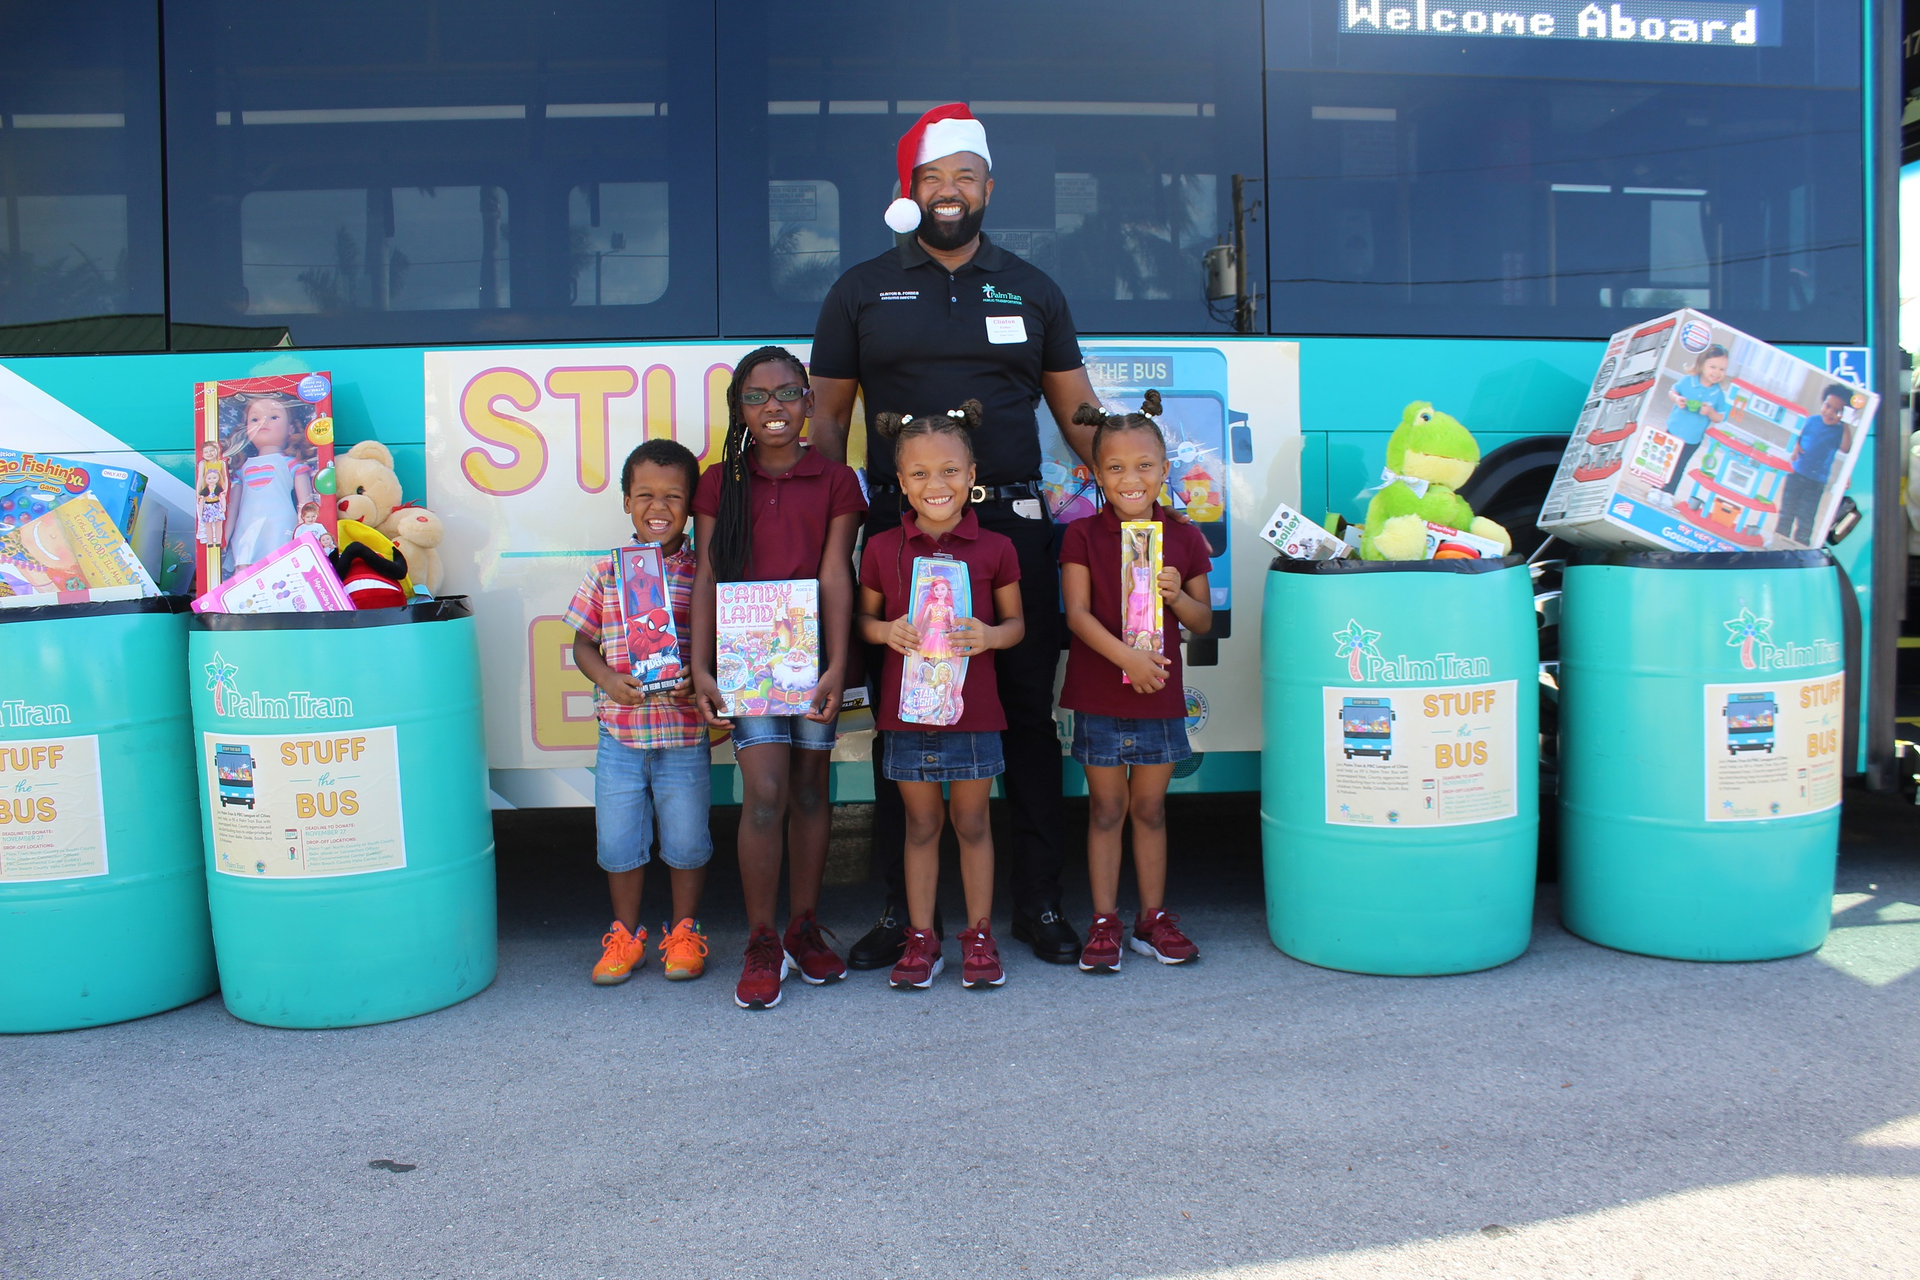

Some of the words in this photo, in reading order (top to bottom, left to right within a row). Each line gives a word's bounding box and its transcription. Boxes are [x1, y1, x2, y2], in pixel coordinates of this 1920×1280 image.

[1347, 0, 1555, 35] Welcome
[1578, 3, 1758, 44] Aboard
[1098, 362, 1129, 381] THE
[1133, 362, 1168, 381] BUS
[459, 362, 812, 497] STU
[21, 454, 75, 480] Fishin'
[68, 473, 85, 488] XL
[38, 483, 62, 493] Game
[82, 503, 110, 542] Today
[109, 545, 132, 573] Feel
[1274, 514, 1301, 548] Bailey
[720, 582, 792, 604] CANDY
[720, 603, 774, 625] LAND
[1366, 654, 1437, 682] Palm
[1435, 652, 1490, 679] Tran
[1759, 642, 1815, 670] Palm
[226, 691, 290, 719] Palm
[288, 691, 354, 719] Tran
[913, 697, 935, 707] LIGHT
[914, 688, 935, 698] STAR
[1423, 689, 1496, 718] STUFF
[2, 700, 71, 728] Tran
[280, 736, 366, 766] STUFF
[1435, 740, 1488, 769] BUS
[1807, 728, 1836, 758] BUS
[15, 779, 32, 793] the
[318, 772, 335, 787] the
[0, 796, 57, 824] BUS
[295, 789, 359, 819] BUS
